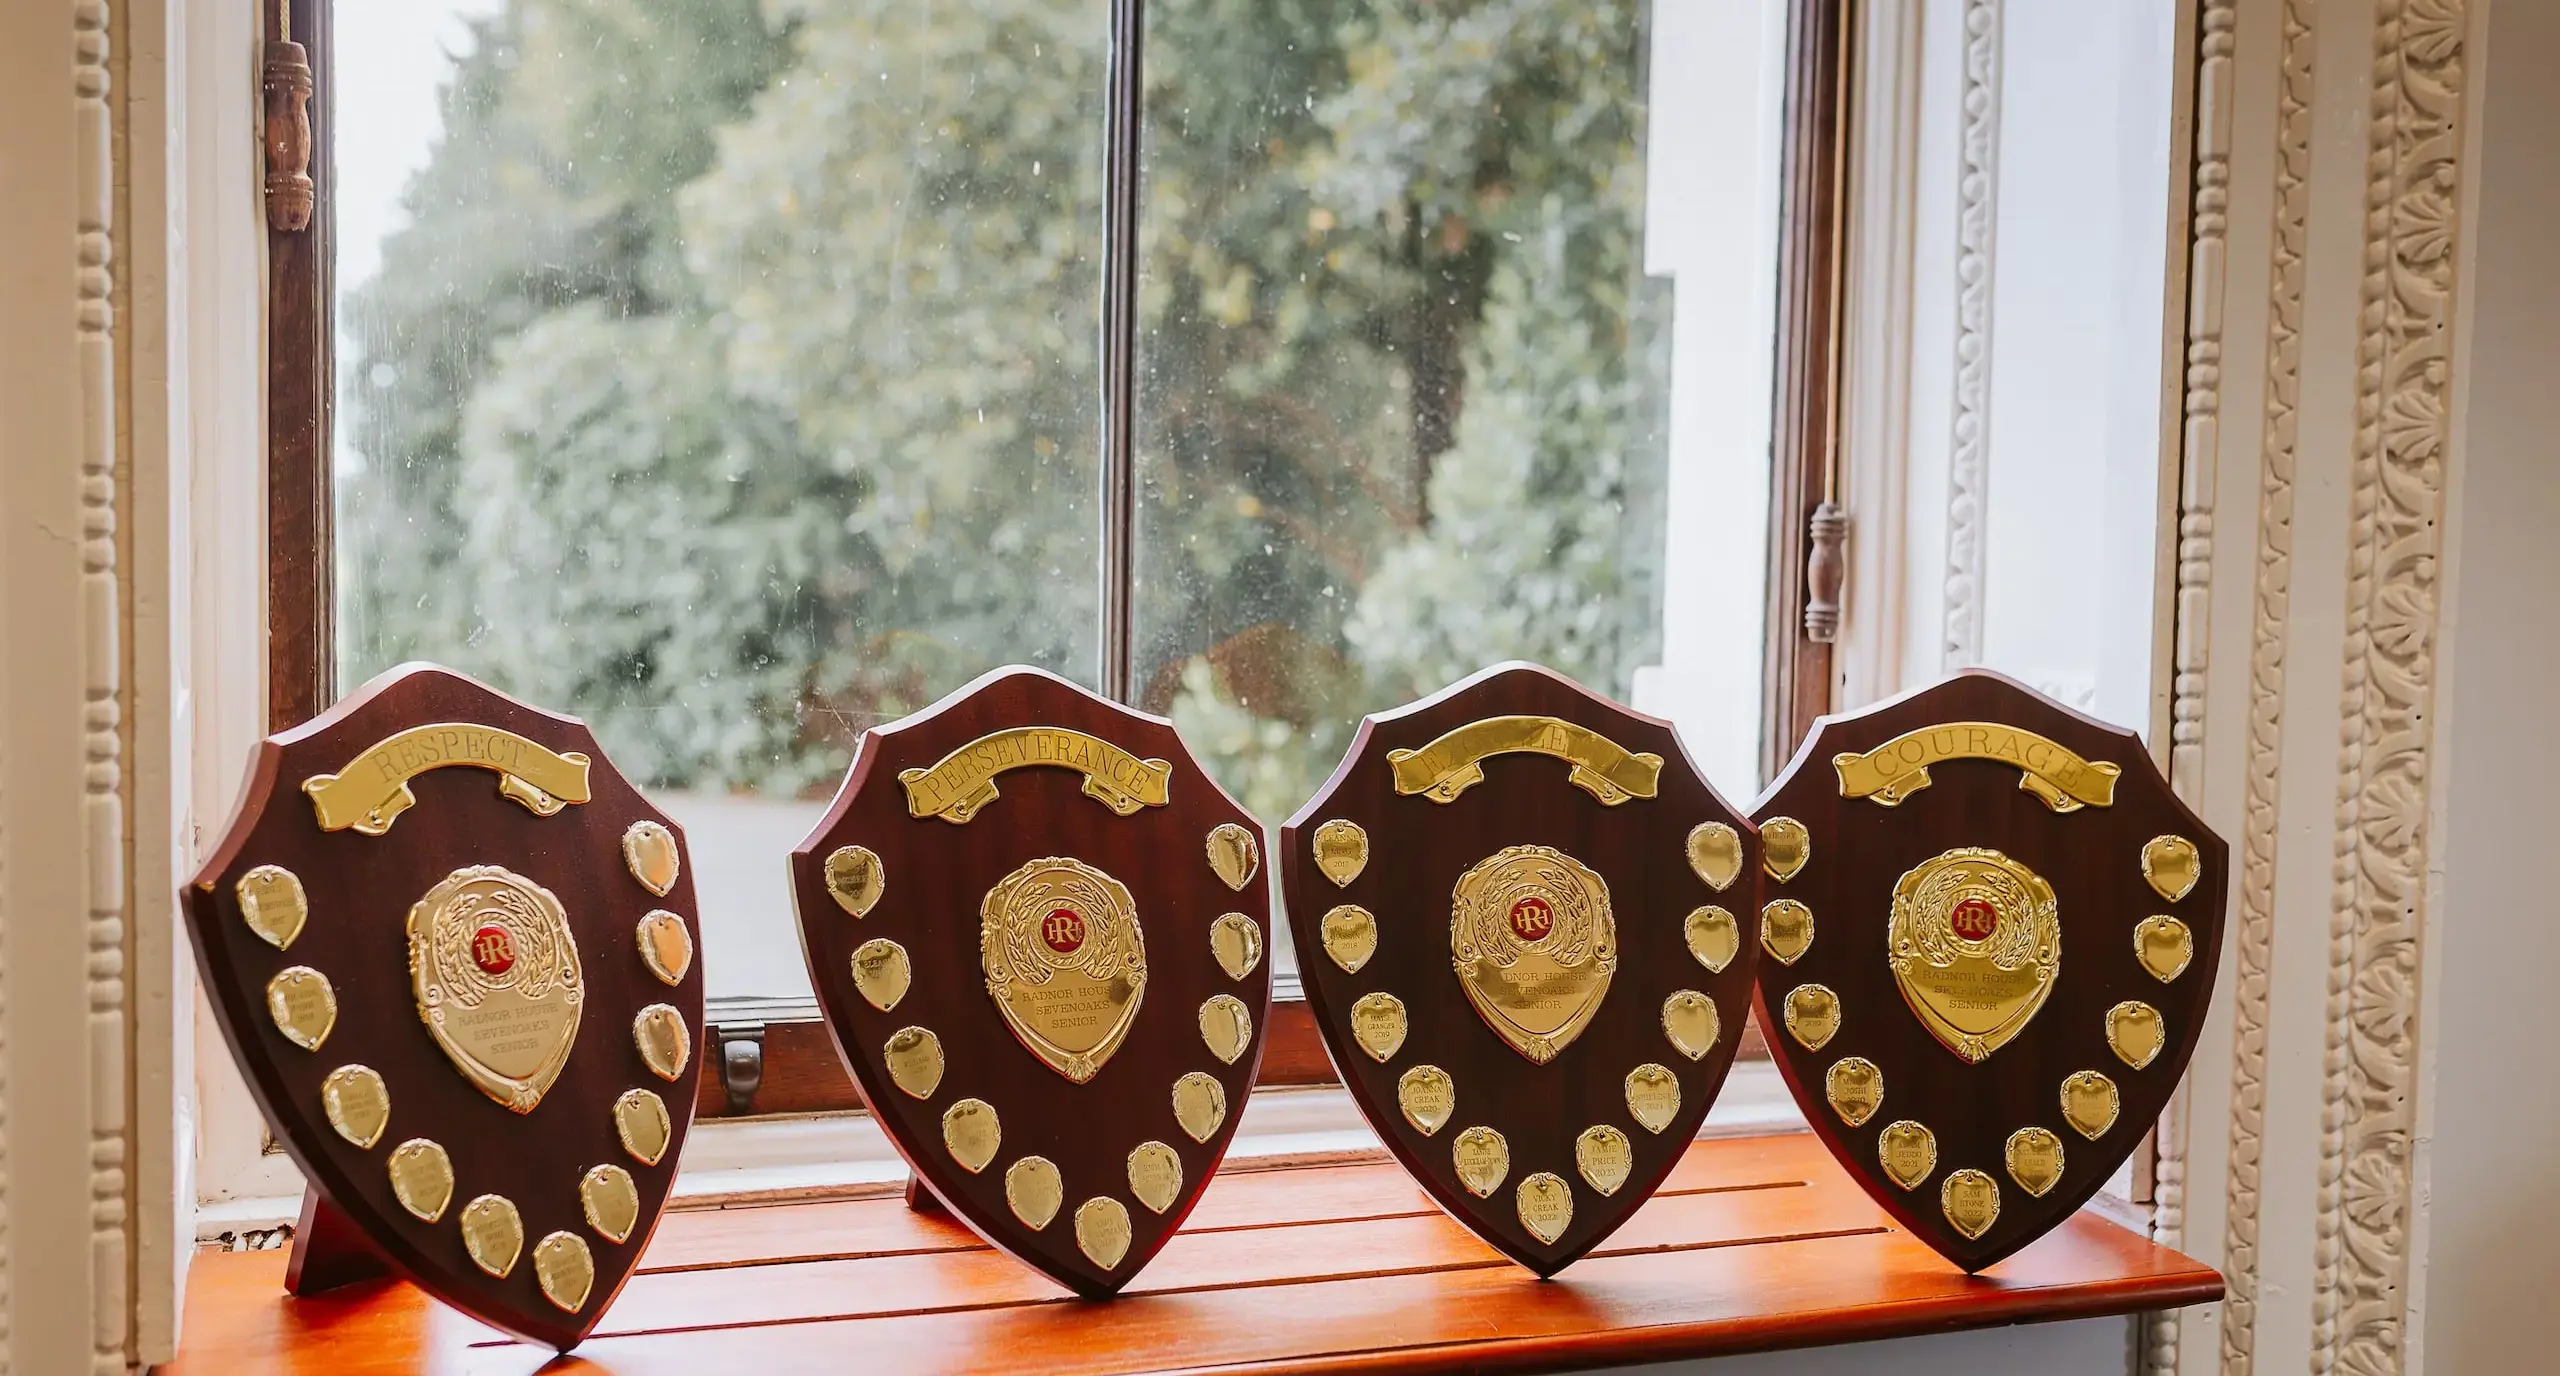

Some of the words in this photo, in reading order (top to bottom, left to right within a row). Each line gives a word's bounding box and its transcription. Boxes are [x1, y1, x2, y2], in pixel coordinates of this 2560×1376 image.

[369, 731, 528, 783] RESPECT
[1873, 728, 2088, 789] COURAGE
[921, 732, 1150, 806] PERSEVERANCE
[1544, 971, 1588, 982] HOUSE
[1921, 971, 1976, 983] RADNOR
[1981, 973, 2025, 984] HOUSE
[1022, 988, 1073, 1003] RADNOR
[1078, 986, 1113, 997] HOUS
[1036, 1000, 1110, 1016] SEVENOAKS
[1514, 999, 1562, 1010] SENIOR
[1948, 999, 1998, 1011] SENIOR
[1051, 1015, 1099, 1029] SENIOR
[1411, 1085, 1442, 1095] JOANNA
[1414, 1095, 1441, 1104] CREAK
[1592, 1156, 1617, 1165] PRICE
[1533, 1193, 1557, 1203] VICKY
[1532, 1203, 1559, 1213] CREAK
